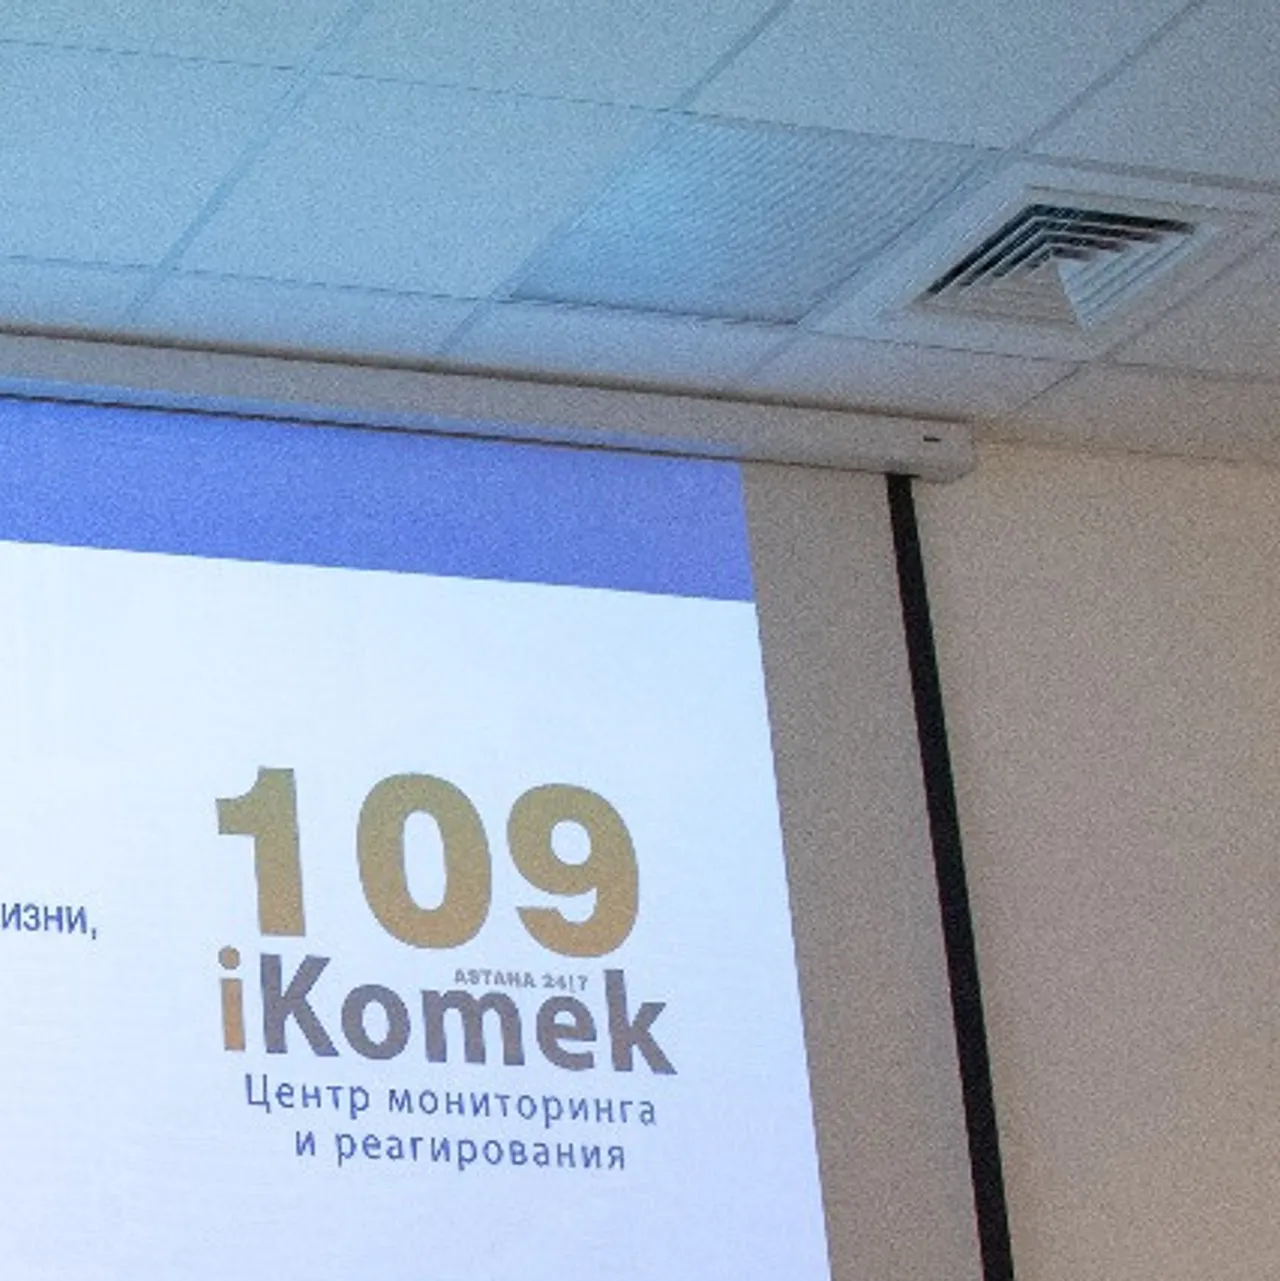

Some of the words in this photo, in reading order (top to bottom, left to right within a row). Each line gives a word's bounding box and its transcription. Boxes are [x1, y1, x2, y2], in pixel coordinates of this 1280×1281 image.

[215, 766, 640, 959] 109
[454, 968, 537, 989] ASTANA
[218, 945, 678, 1076] iKomek
[244, 1073, 370, 1120] Центр
[388, 1088, 657, 1130] мониторинга
[295, 1130, 316, 1157] и
[334, 1133, 626, 1172] реагирования
